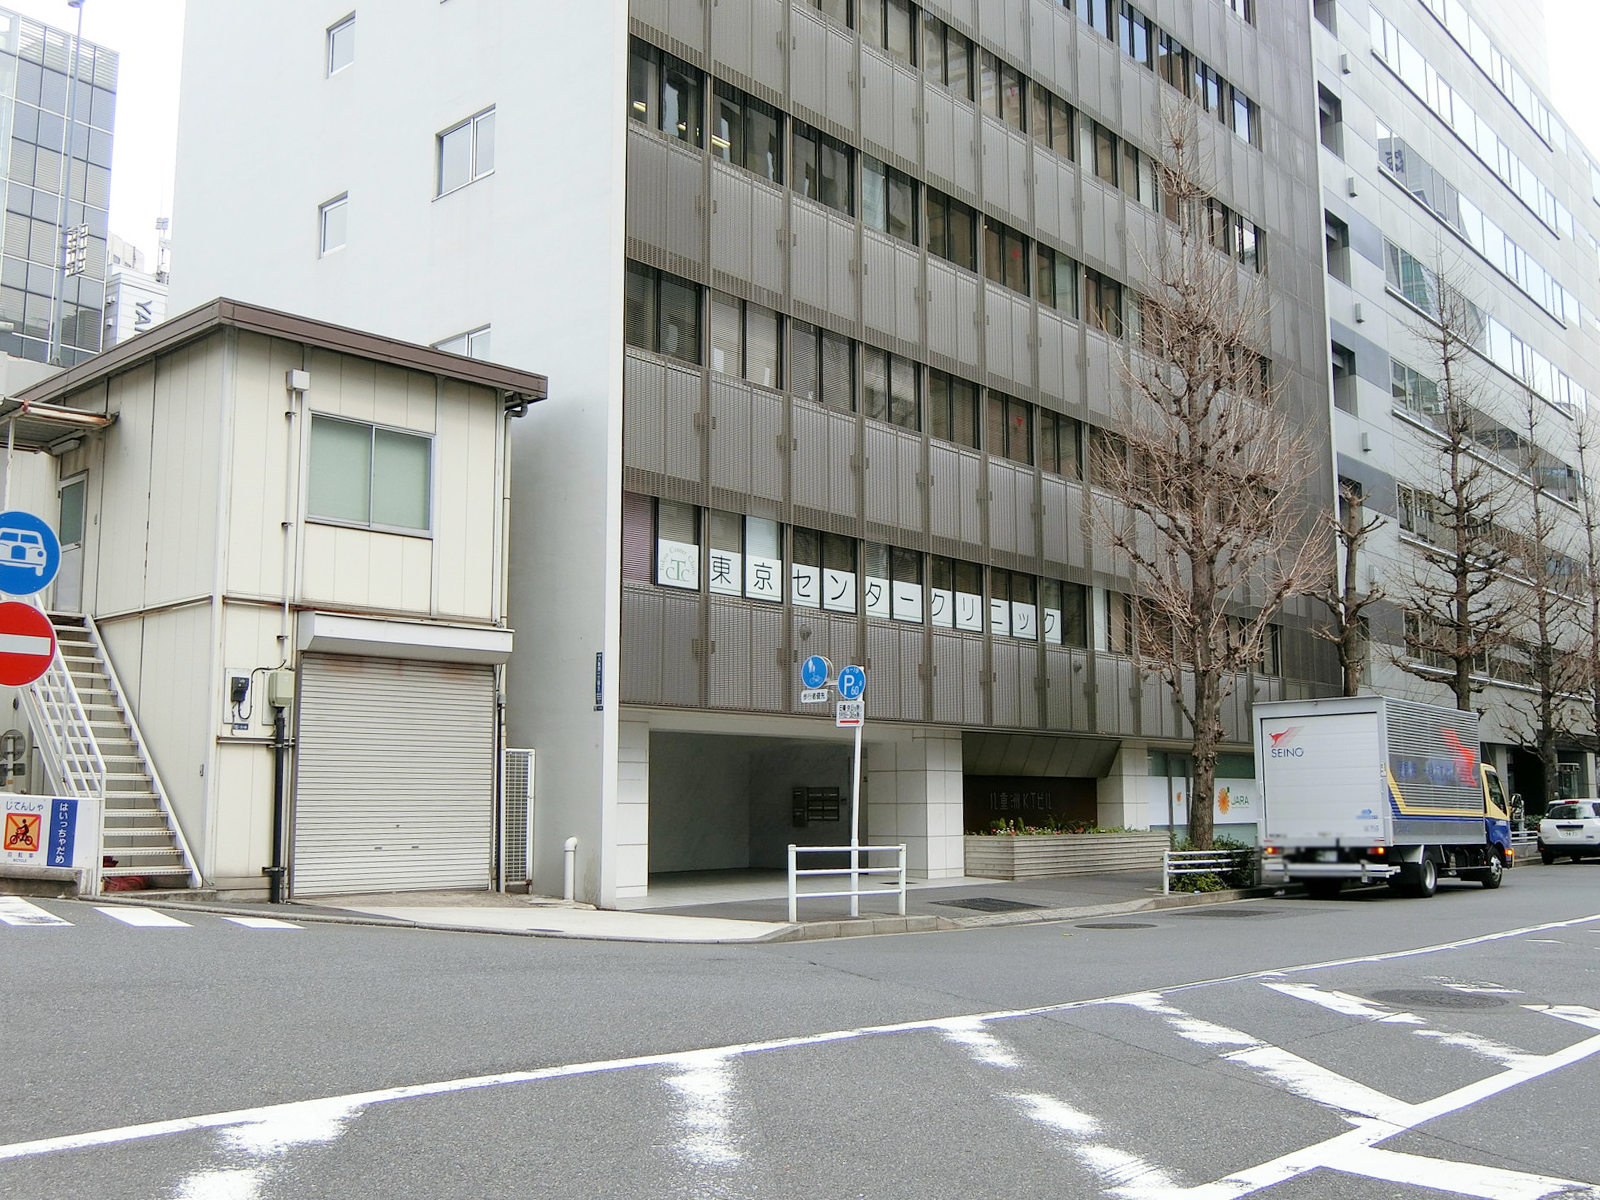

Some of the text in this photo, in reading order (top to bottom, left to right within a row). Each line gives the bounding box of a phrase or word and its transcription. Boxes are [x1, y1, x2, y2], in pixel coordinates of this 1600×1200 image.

[711, 555, 1055, 634] 東京センタークリニック
[843, 674, 855, 696] P
[1271, 746, 1304, 758] SEINO
[6, 800, 44, 812] じてんしゃ
[55, 803, 69, 864] はいっちゃだめ
